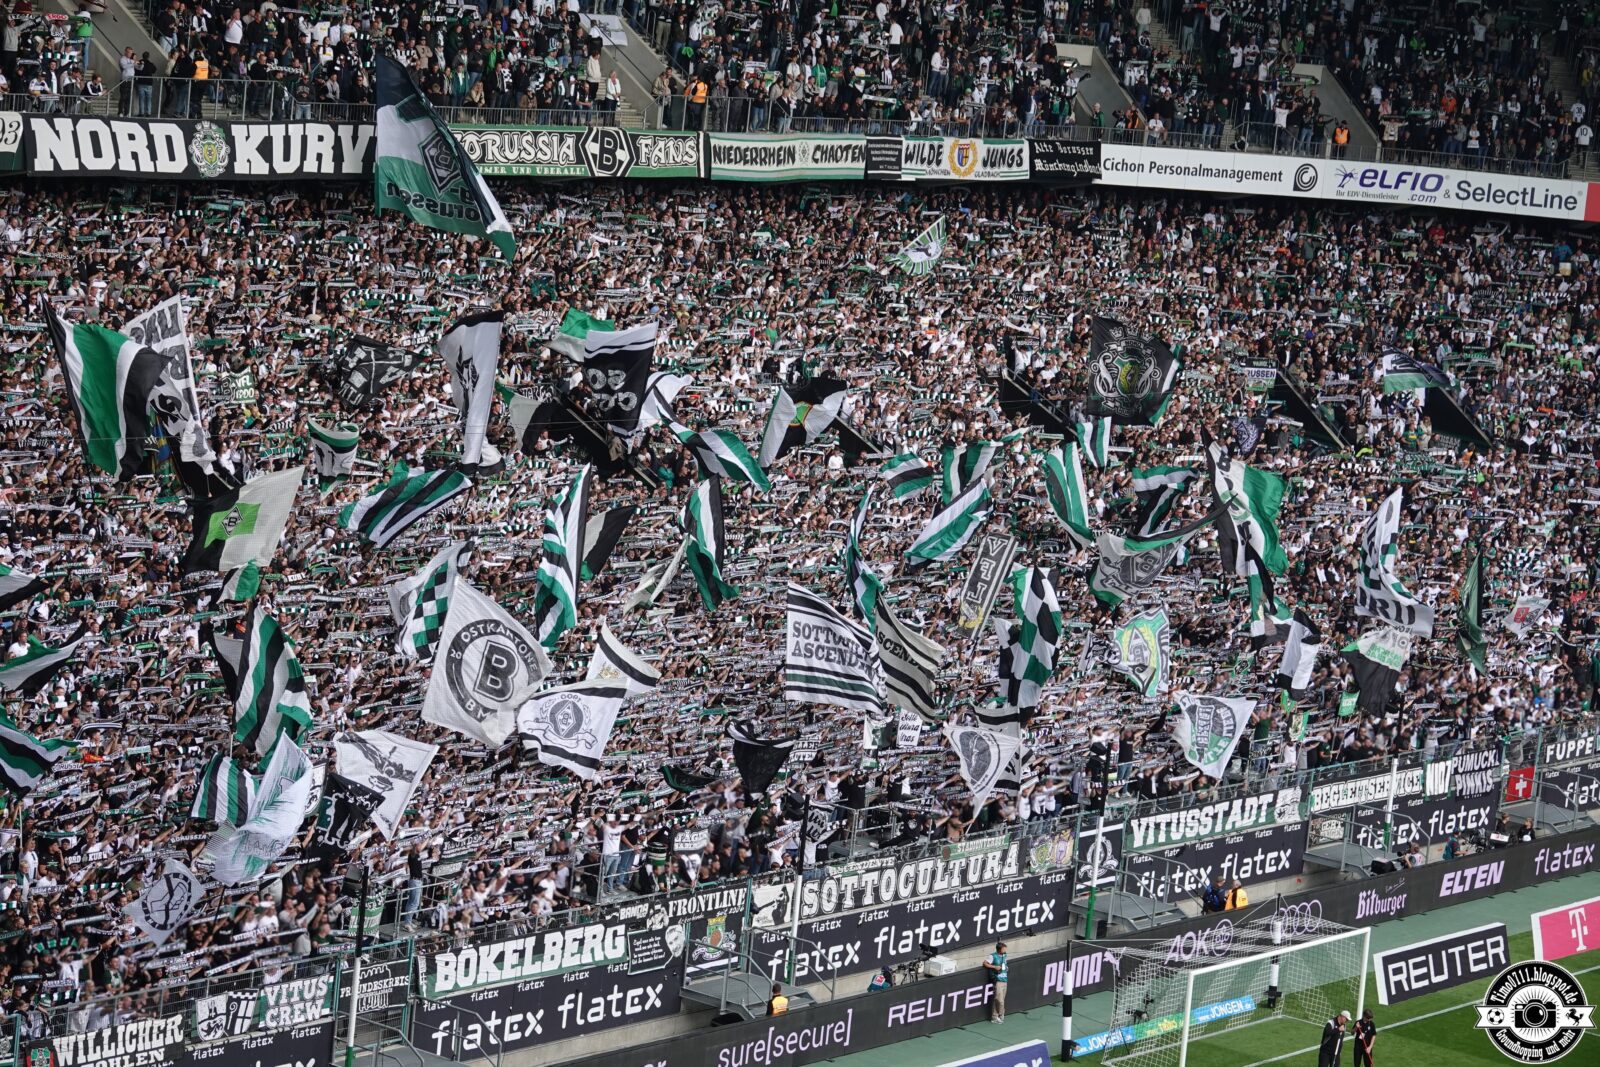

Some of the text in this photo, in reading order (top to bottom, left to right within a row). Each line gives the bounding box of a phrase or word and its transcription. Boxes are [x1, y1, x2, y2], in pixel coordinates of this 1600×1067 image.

[31, 117, 376, 175] NORD KURV
[1580, 127, 1588, 136] 10
[456, 131, 577, 167] ORUSSIA
[637, 136, 698, 168] FANS
[713, 143, 797, 167] NIEDERRHEIN
[811, 142, 866, 165] CHAOTEN
[904, 142, 944, 168] WILDE
[982, 144, 1025, 169] JUNGS
[512, 166, 532, 176] UND
[1103, 157, 1284, 183] Cichon Personalmanagement
[1407, 190, 1451, 204] .com &
[1455, 180, 1578, 211] SelectLine
[236, 375, 252, 388] VFL
[236, 387, 254, 399] 1900
[450, 648, 463, 661] 20
[460, 621, 538, 672] OSTKANTONE
[1131, 793, 1275, 848] VITUSSTADT
[1225, 835, 1244, 845] flatex
[1254, 829, 1273, 839] flatex
[1283, 823, 1302, 833] flatex
[1429, 806, 1491, 837] flatex
[1220, 848, 1292, 880] flatex
[1534, 843, 1596, 876] flatex
[801, 841, 1020, 918] SOTTOCULTURA
[1439, 860, 1505, 898] ELTEN
[668, 887, 747, 918] FRONTLINE
[811, 917, 842, 933] flatex
[859, 908, 890, 925] flatex
[906, 898, 936, 913] flatex
[952, 890, 980, 904] flatex
[996, 880, 1024, 894] flatex
[1039, 872, 1067, 885] flatex
[1356, 887, 1407, 919] Bitburger
[874, 919, 962, 959] flatex
[973, 898, 1056, 937] flatex
[434, 923, 627, 992] BÖKELBERG
[1388, 935, 1507, 996] REUTER
[264, 974, 330, 1006] VITUS
[340, 974, 409, 998] FRUNDESKREIS
[470, 989, 500, 1001] flatex
[517, 980, 545, 992] flatex
[562, 970, 590, 982] flatex
[607, 962, 628, 974] flate
[265, 997, 324, 1029] CREW
[557, 983, 664, 1029] flatex
[1209, 999, 1243, 1019] JONGEN
[53, 1014, 184, 1067] WILLICHER
[192, 1026, 322, 1060] flatex flatex flatex
[718, 1009, 853, 1067] sure[secure]
